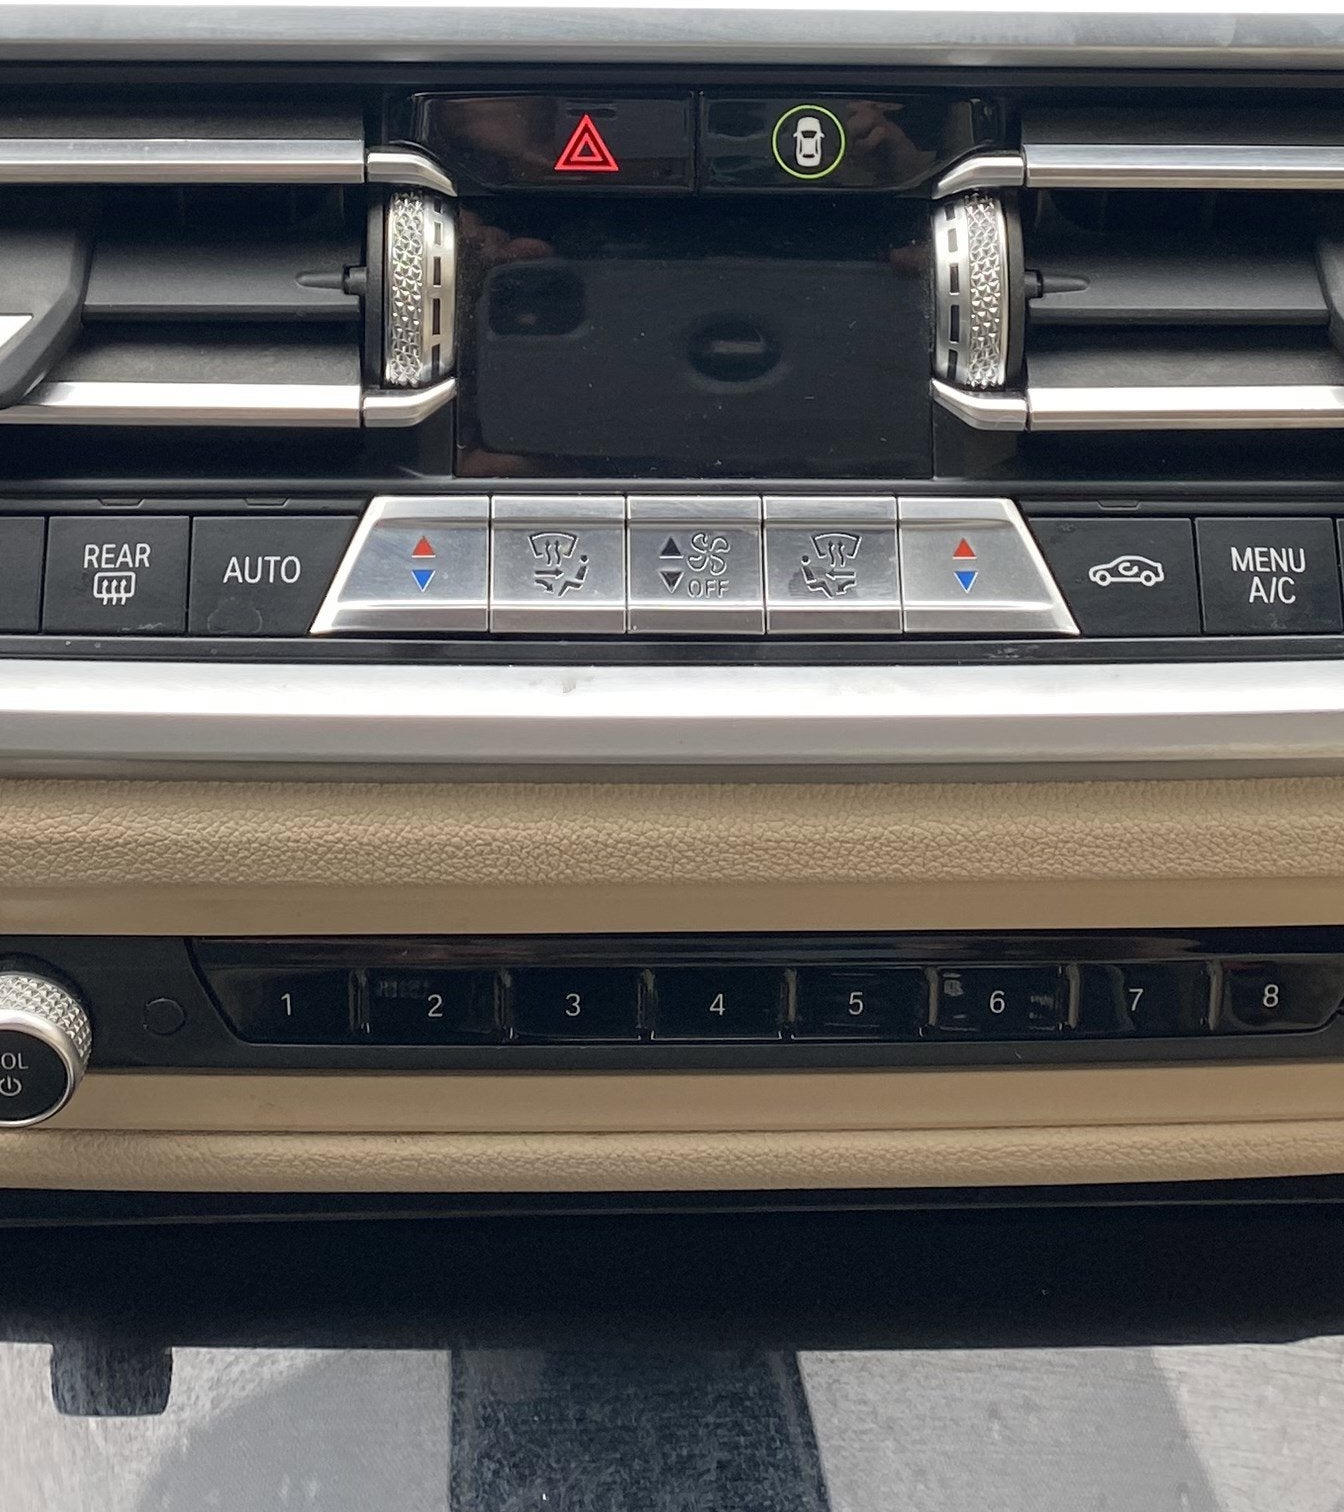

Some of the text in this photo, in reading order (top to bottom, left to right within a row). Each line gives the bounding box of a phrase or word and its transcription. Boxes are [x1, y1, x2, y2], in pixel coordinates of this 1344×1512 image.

[84, 544, 150, 568] REAR
[1231, 547, 1305, 572] MENU
[223, 556, 300, 583] AUTO
[688, 579, 729, 598] OFF
[1249, 577, 1295, 603] A/C
[282, 994, 291, 1015] 1
[428, 994, 442, 1017] 2
[566, 994, 580, 1016] 3
[710, 994, 725, 1015] 4
[849, 992, 863, 1015] 5
[990, 991, 1005, 1013] 6
[1130, 989, 1143, 1010] 7
[1263, 984, 1278, 1007] 8
